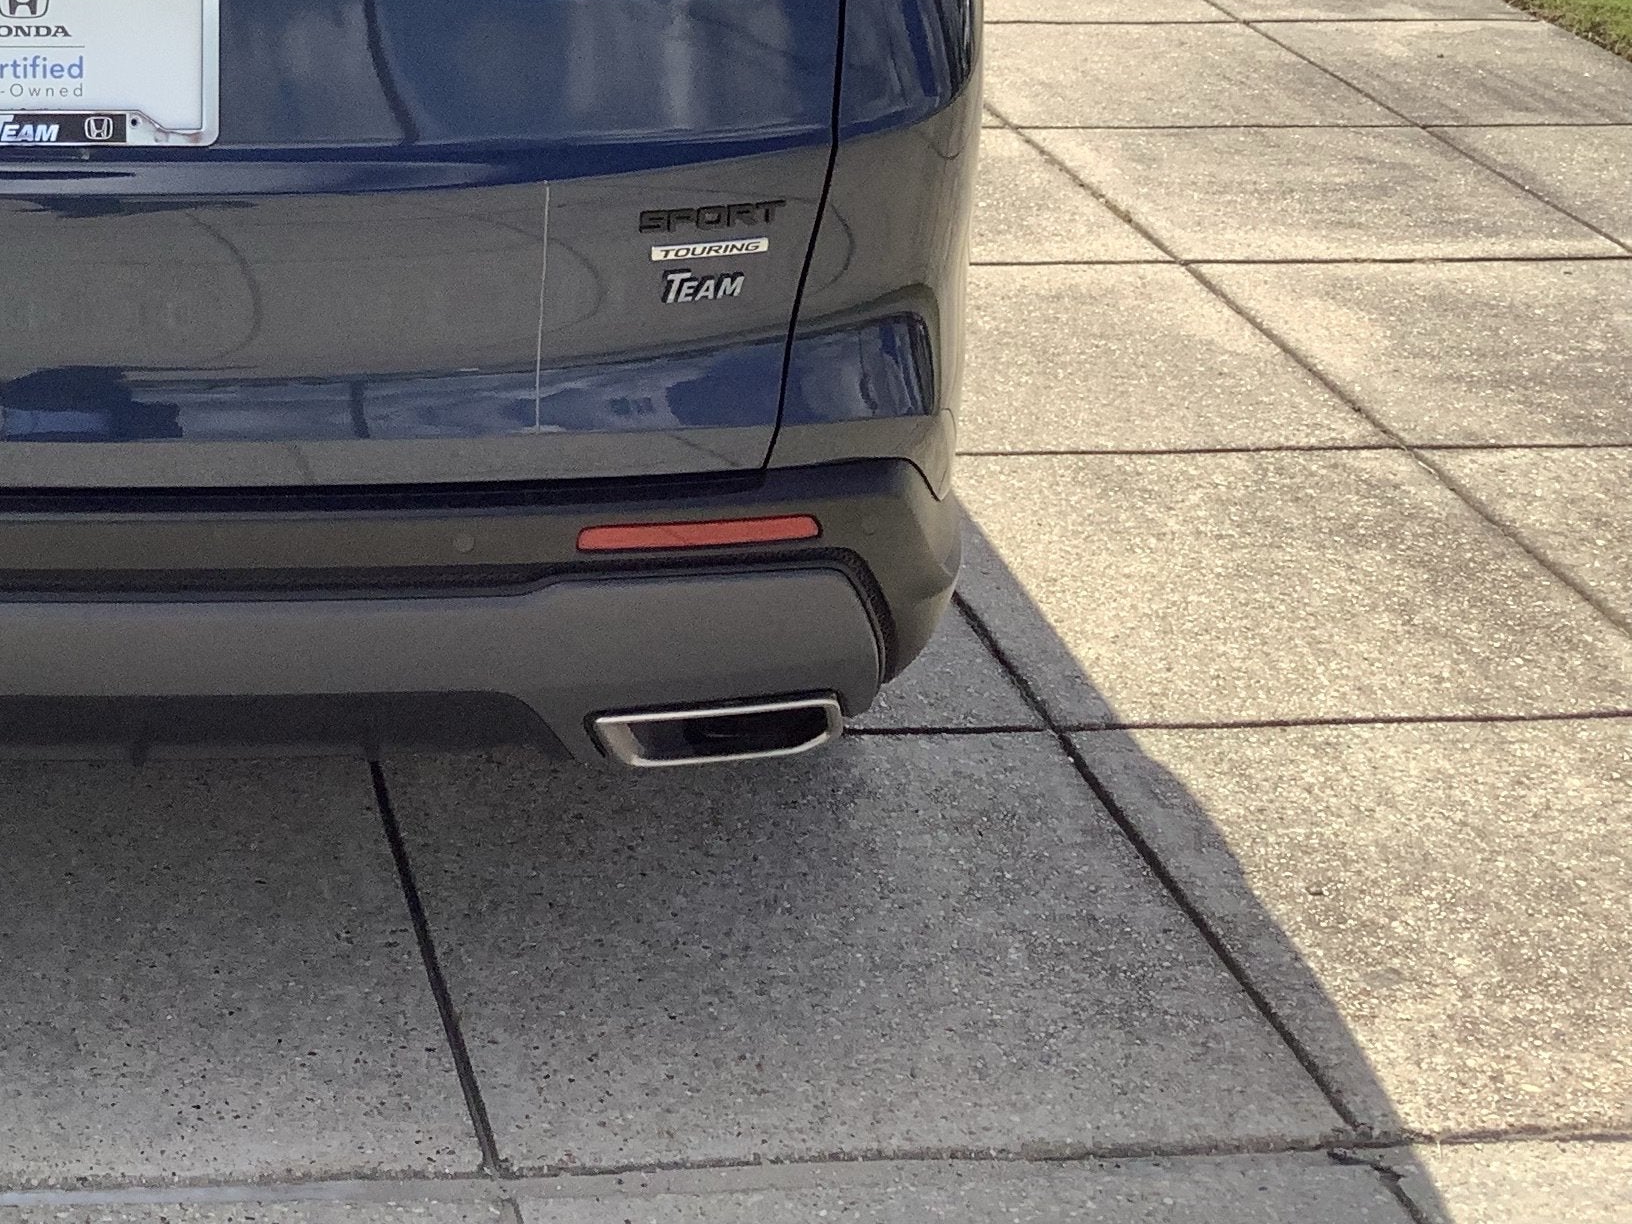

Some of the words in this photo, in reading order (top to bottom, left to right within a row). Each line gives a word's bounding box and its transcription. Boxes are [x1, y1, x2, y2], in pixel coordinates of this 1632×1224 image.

[639, 199, 786, 233] SPORT
[660, 241, 761, 259] TOURING
[665, 271, 745, 304] TEAM
